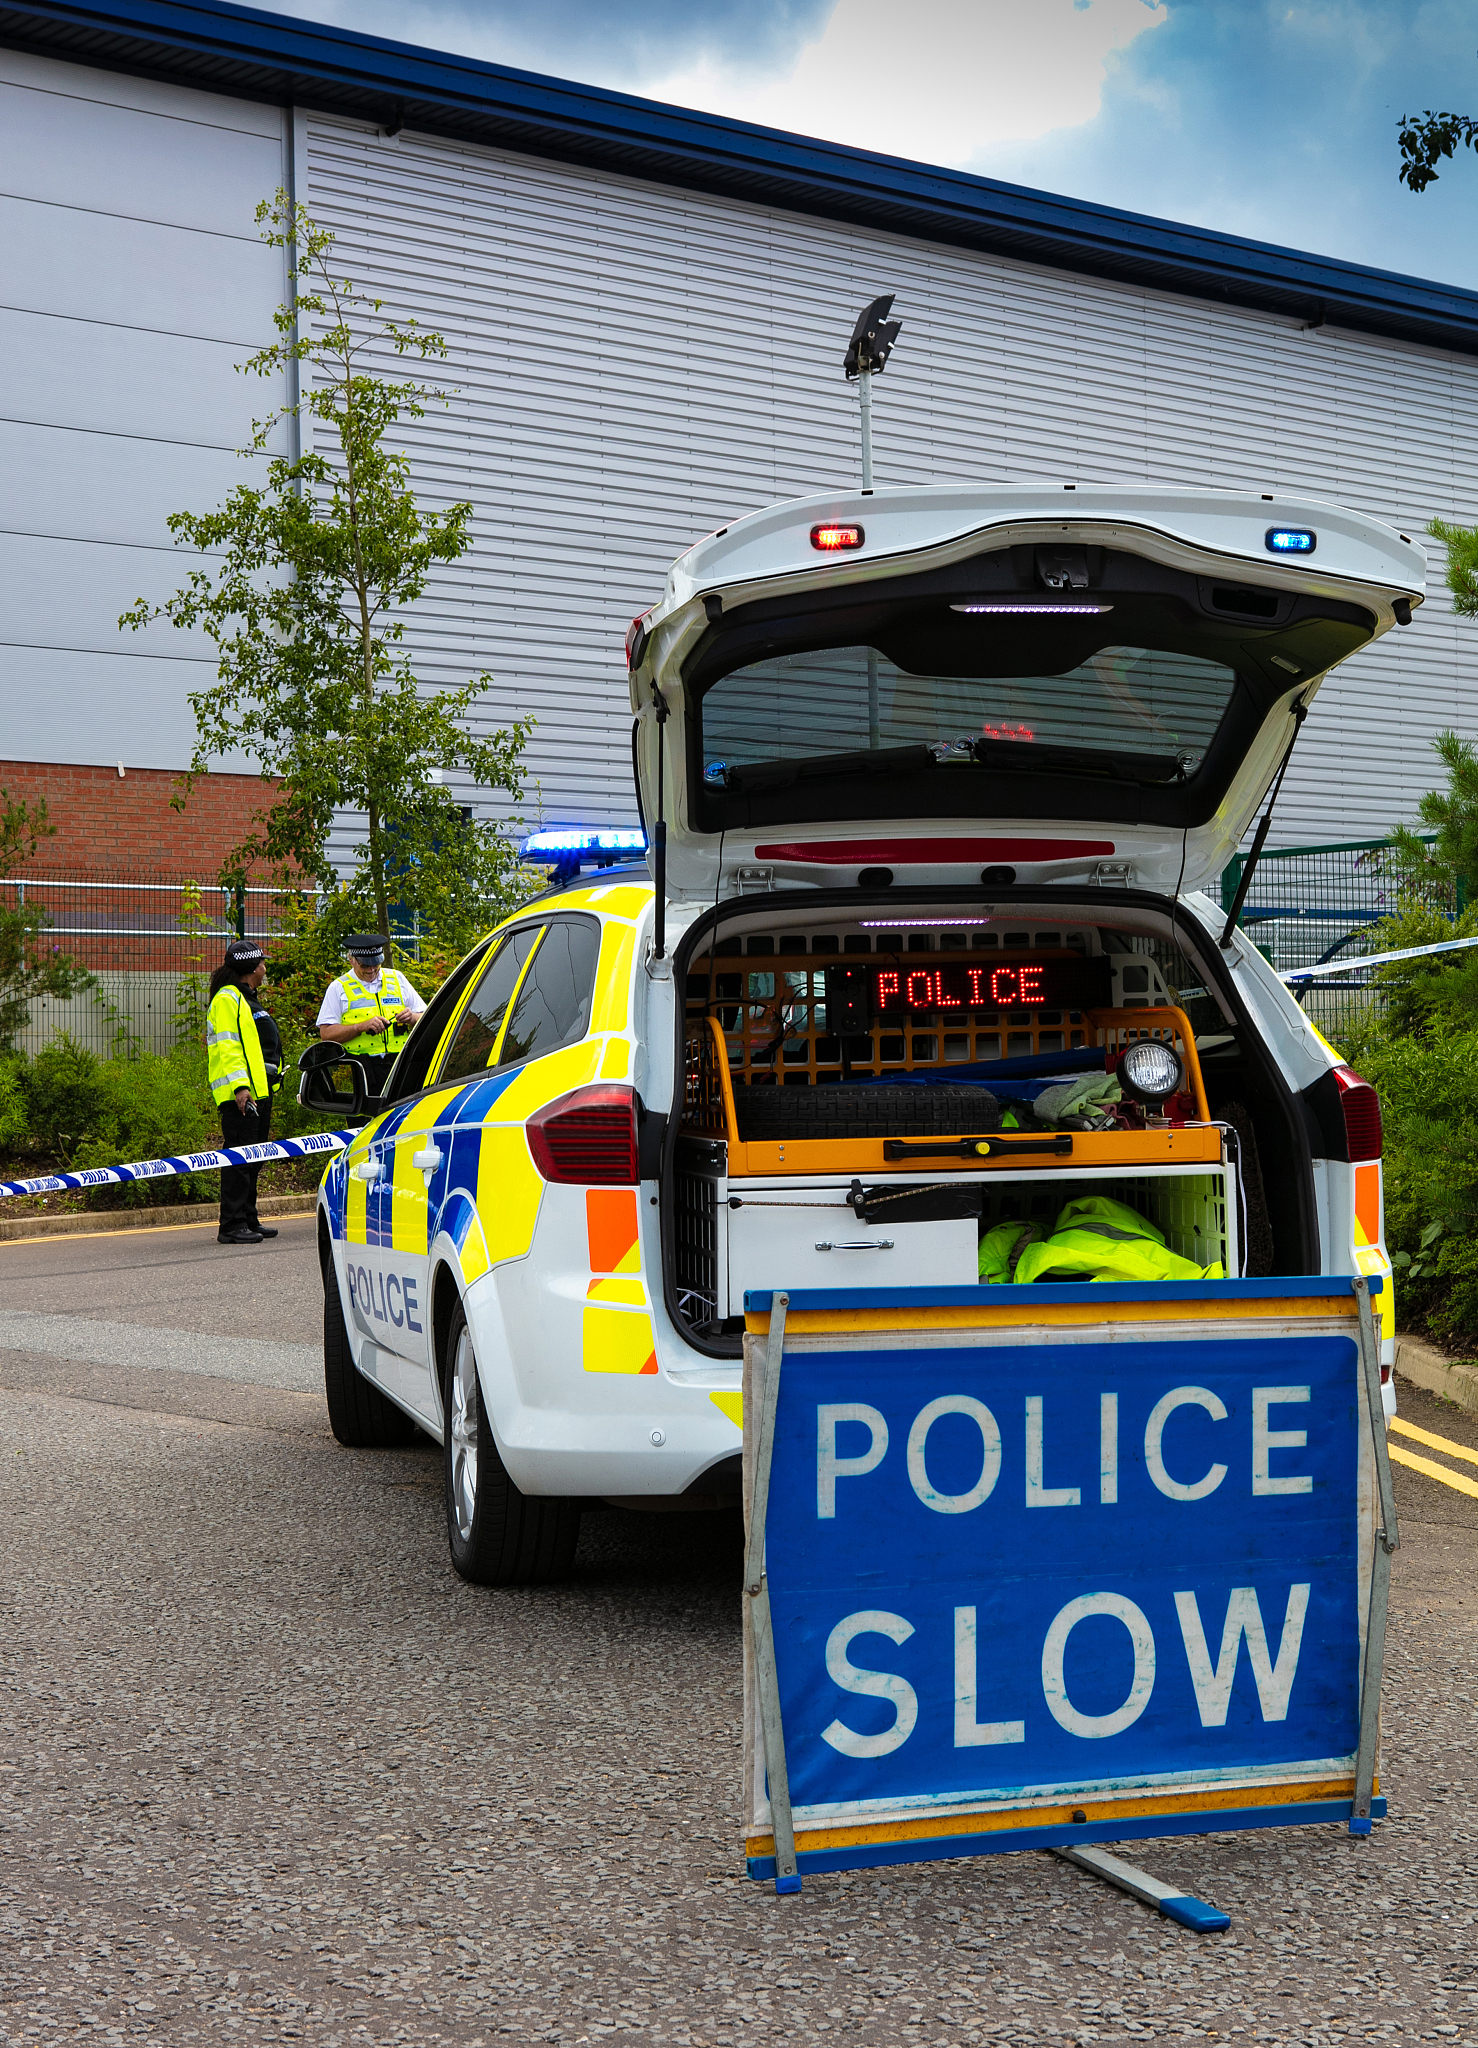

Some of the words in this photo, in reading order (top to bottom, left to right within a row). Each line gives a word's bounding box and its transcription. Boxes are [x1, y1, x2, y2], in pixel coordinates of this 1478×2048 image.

[878, 967, 1045, 1008] POLICE
[80, 1169, 109, 1184] POLICE
[188, 1152, 219, 1168] POLICE
[301, 1134, 333, 1151] POLICE
[347, 1262, 423, 1334] POLICE
[816, 1385, 1314, 1520] POLICE
[820, 1583, 1311, 1759] SLOW
